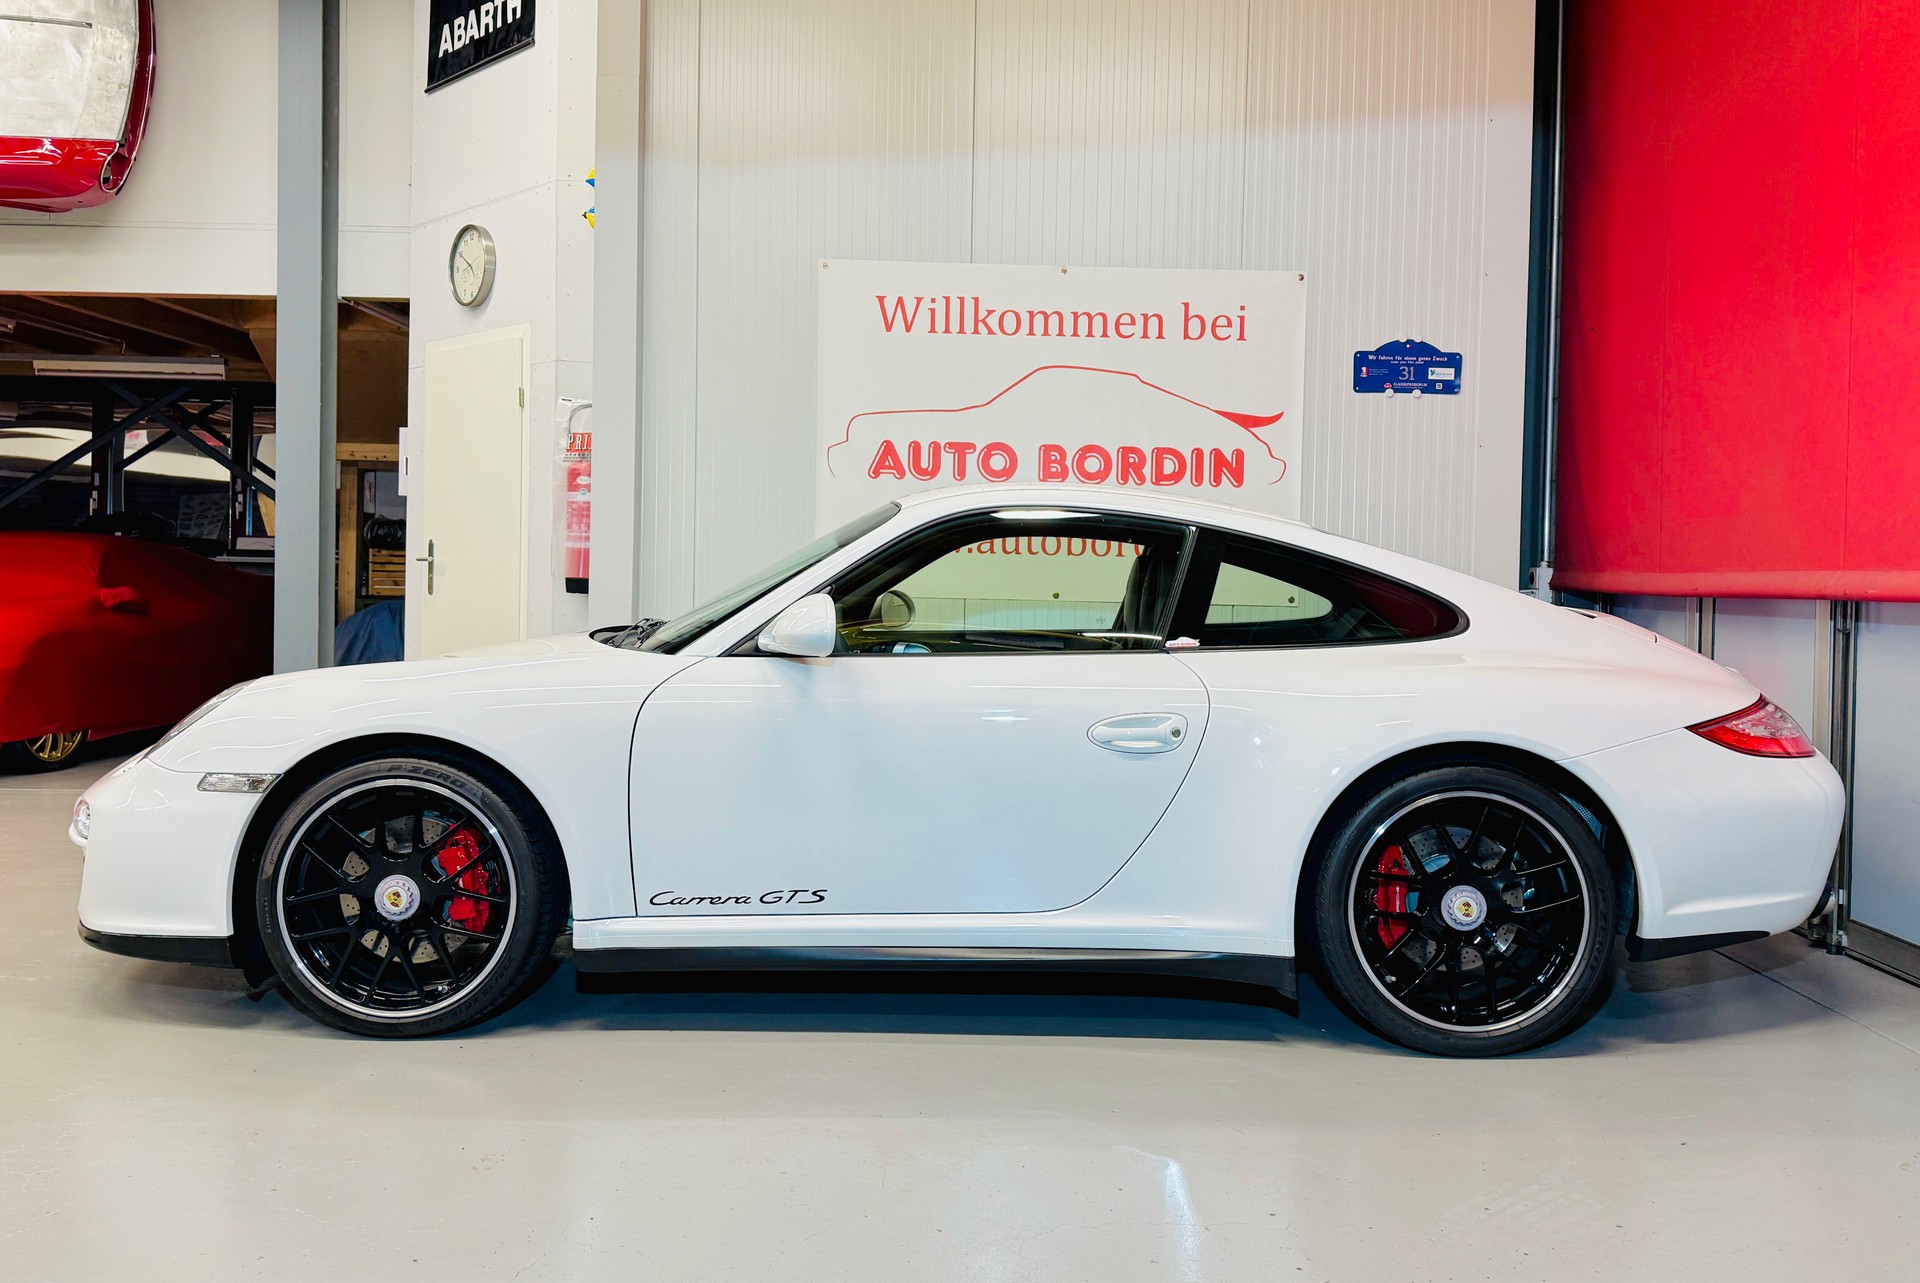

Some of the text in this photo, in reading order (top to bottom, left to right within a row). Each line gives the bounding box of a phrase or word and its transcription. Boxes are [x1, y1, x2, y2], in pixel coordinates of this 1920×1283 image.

[438, 0, 521, 58] ABARTH
[875, 295, 1247, 342] Willkommen bei
[1399, 366, 1415, 381] 31
[566, 433, 592, 451] PRI
[867, 439, 1245, 489] AUTO BORDIN
[407, 765, 468, 789] ZERO
[649, 889, 828, 906] Carrera GTS
